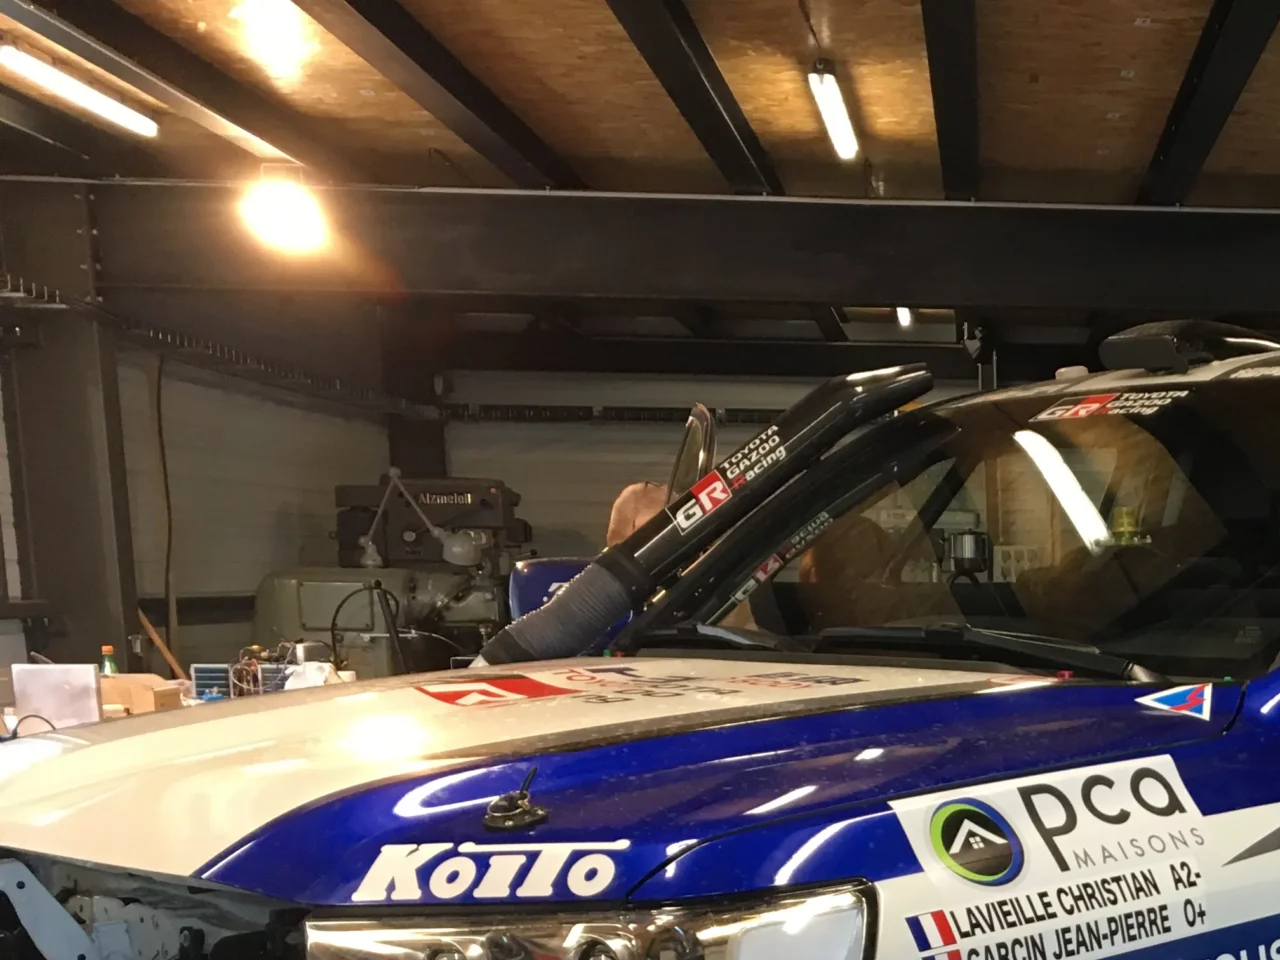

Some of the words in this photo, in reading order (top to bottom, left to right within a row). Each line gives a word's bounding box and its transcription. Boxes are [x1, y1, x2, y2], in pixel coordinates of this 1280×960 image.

[1036, 403, 1103, 420] GR
[1095, 405, 1160, 416] Racing
[1105, 398, 1172, 408] GAZOO
[1117, 389, 1190, 401] TOYOTA
[720, 424, 779, 470] TOYOTA
[726, 434, 781, 480] GAZOO
[731, 446, 787, 490] Racing
[676, 480, 729, 529] GR
[1017, 767, 1187, 872] pca
[1072, 826, 1207, 870] MAISONS
[950, 891, 1058, 940] LAVIEILLE
[1060, 867, 1160, 915] CHRISTIAN
[1172, 860, 1203, 892] A2-
[1052, 903, 1172, 960] JEAN-PIERRE
